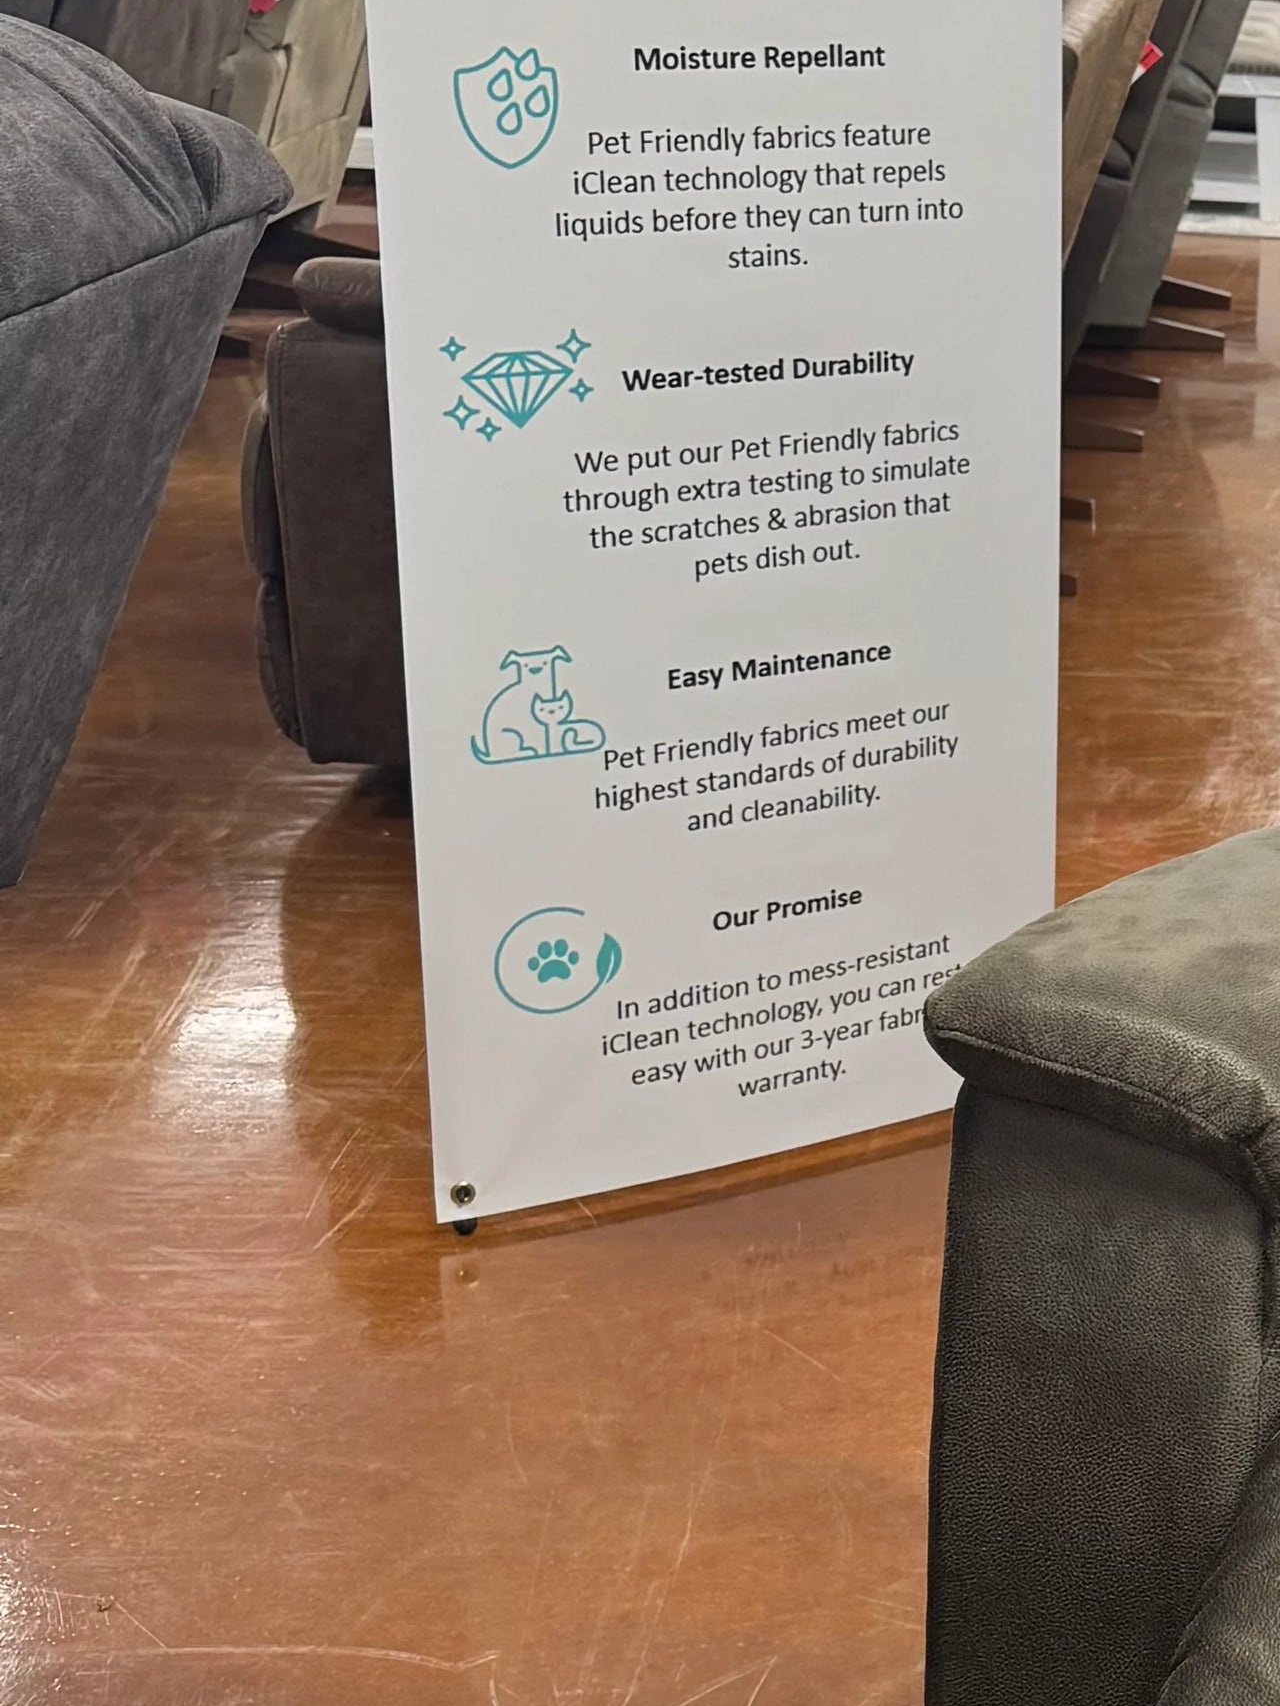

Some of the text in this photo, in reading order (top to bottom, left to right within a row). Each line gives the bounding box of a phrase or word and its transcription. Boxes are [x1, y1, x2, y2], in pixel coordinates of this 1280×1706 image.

[634, 44, 885, 74] Moisture Repellant
[589, 124, 930, 156] Pet Friendly fabrics feature
[574, 159, 945, 195] iClean technology that repels
[556, 198, 963, 242] liquids before they can turn into
[729, 243, 808, 268] stains.
[622, 351, 914, 391] Wear-tested Durability
[574, 421, 959, 476] We put our Pet Friendly fabrics
[563, 456, 970, 512] through extra testing to simulate
[589, 493, 950, 549] the scratches & abrasion that
[695, 540, 860, 582] pets dish out.
[668, 645, 891, 690] Easy Maintenance
[604, 704, 949, 771] Pet Friendly fabrics meet our
[596, 735, 958, 811] highest standards of durability
[688, 784, 880, 831] and cleanability.
[713, 889, 862, 930] Our Promise
[618, 935, 949, 1019] In addition to mess-resistant
[602, 964, 961, 1056] iClean technology, you can res
[632, 1007, 922, 1085] easy with our 3-year fabr
[738, 1060, 846, 1096] warranty.
